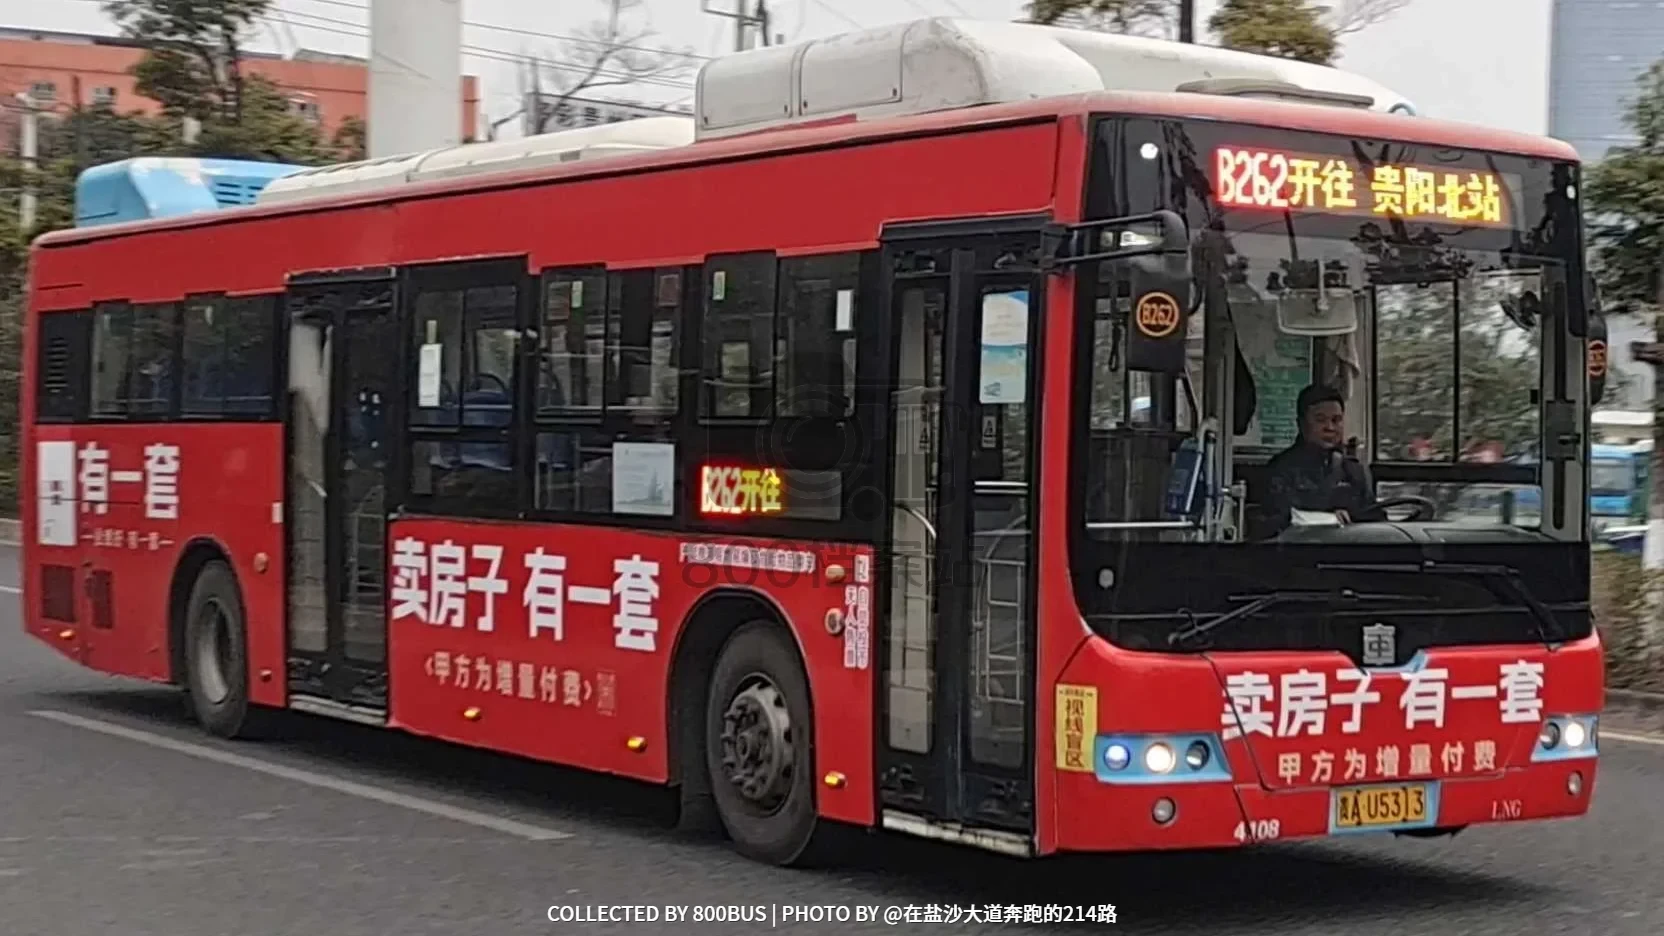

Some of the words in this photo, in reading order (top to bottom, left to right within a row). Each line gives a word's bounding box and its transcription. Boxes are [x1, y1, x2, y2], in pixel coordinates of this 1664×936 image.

[1216, 148, 1357, 208] B262开往
[1371, 164, 1500, 222] 贵阳北站
[1142, 302, 1173, 326] B262
[78, 441, 180, 519] 有一套
[391, 536, 509, 632] 卖房子
[523, 546, 660, 652] 有一套
[1221, 668, 1381, 741] 卖房子
[1400, 660, 1545, 730] 有一套
[1278, 740, 1497, 784] 甲方为增量付费
[1233, 818, 1280, 842] 4108
